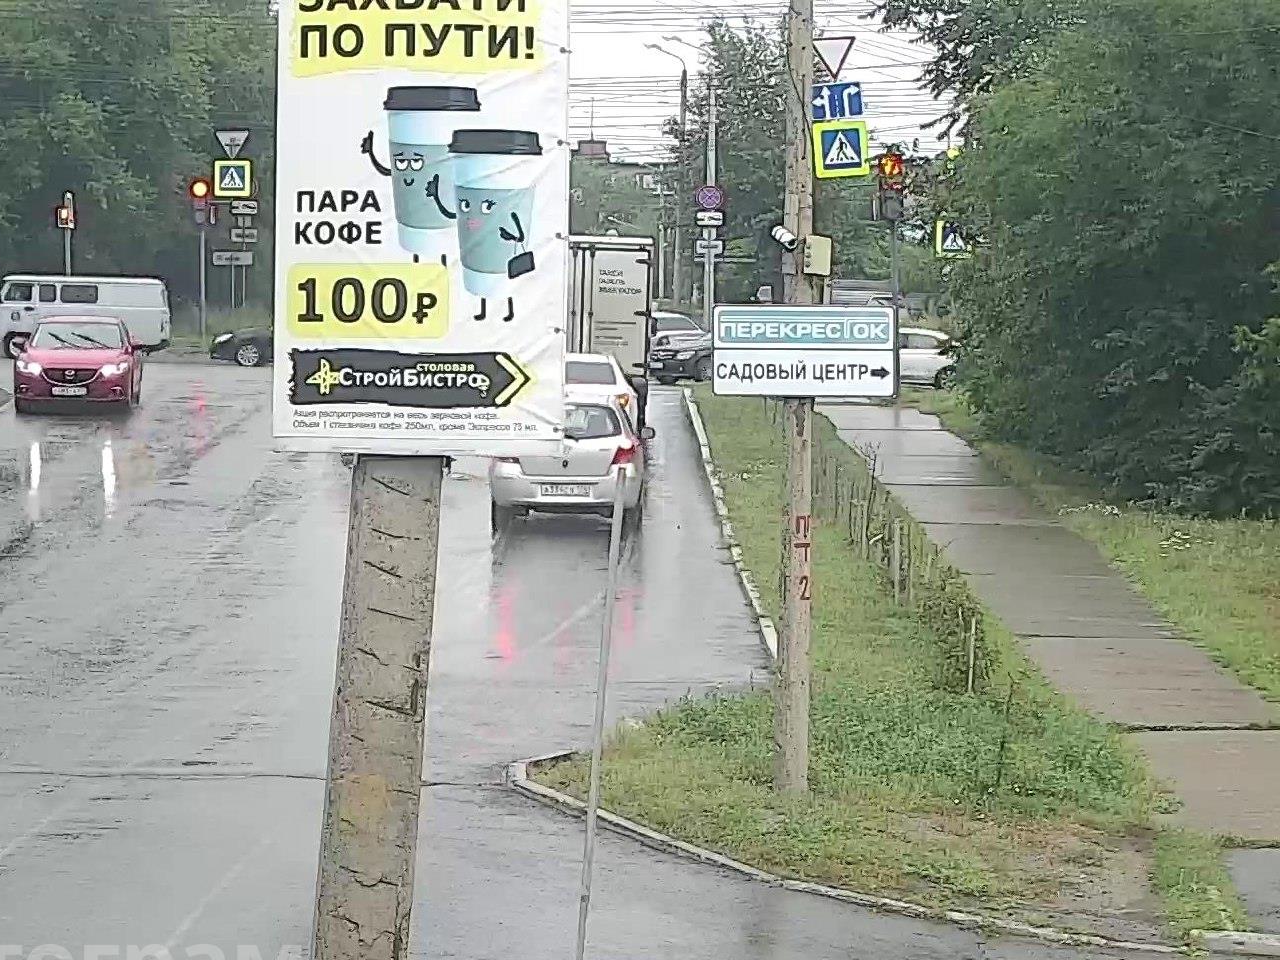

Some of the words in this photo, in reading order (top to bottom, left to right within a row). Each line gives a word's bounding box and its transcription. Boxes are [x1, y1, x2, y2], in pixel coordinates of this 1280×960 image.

[300, 24, 364, 58] ПО
[385, 24, 535, 59] ПУТИ!
[296, 190, 382, 213] ПАРА
[294, 220, 383, 245] КОФЕ
[720, 319, 889, 339] ПЕРЕКРЕСТОК
[415, 363, 476, 373] столовая
[716, 360, 807, 383] САДОВЫЙ
[812, 363, 869, 384] ЦЕНТР
